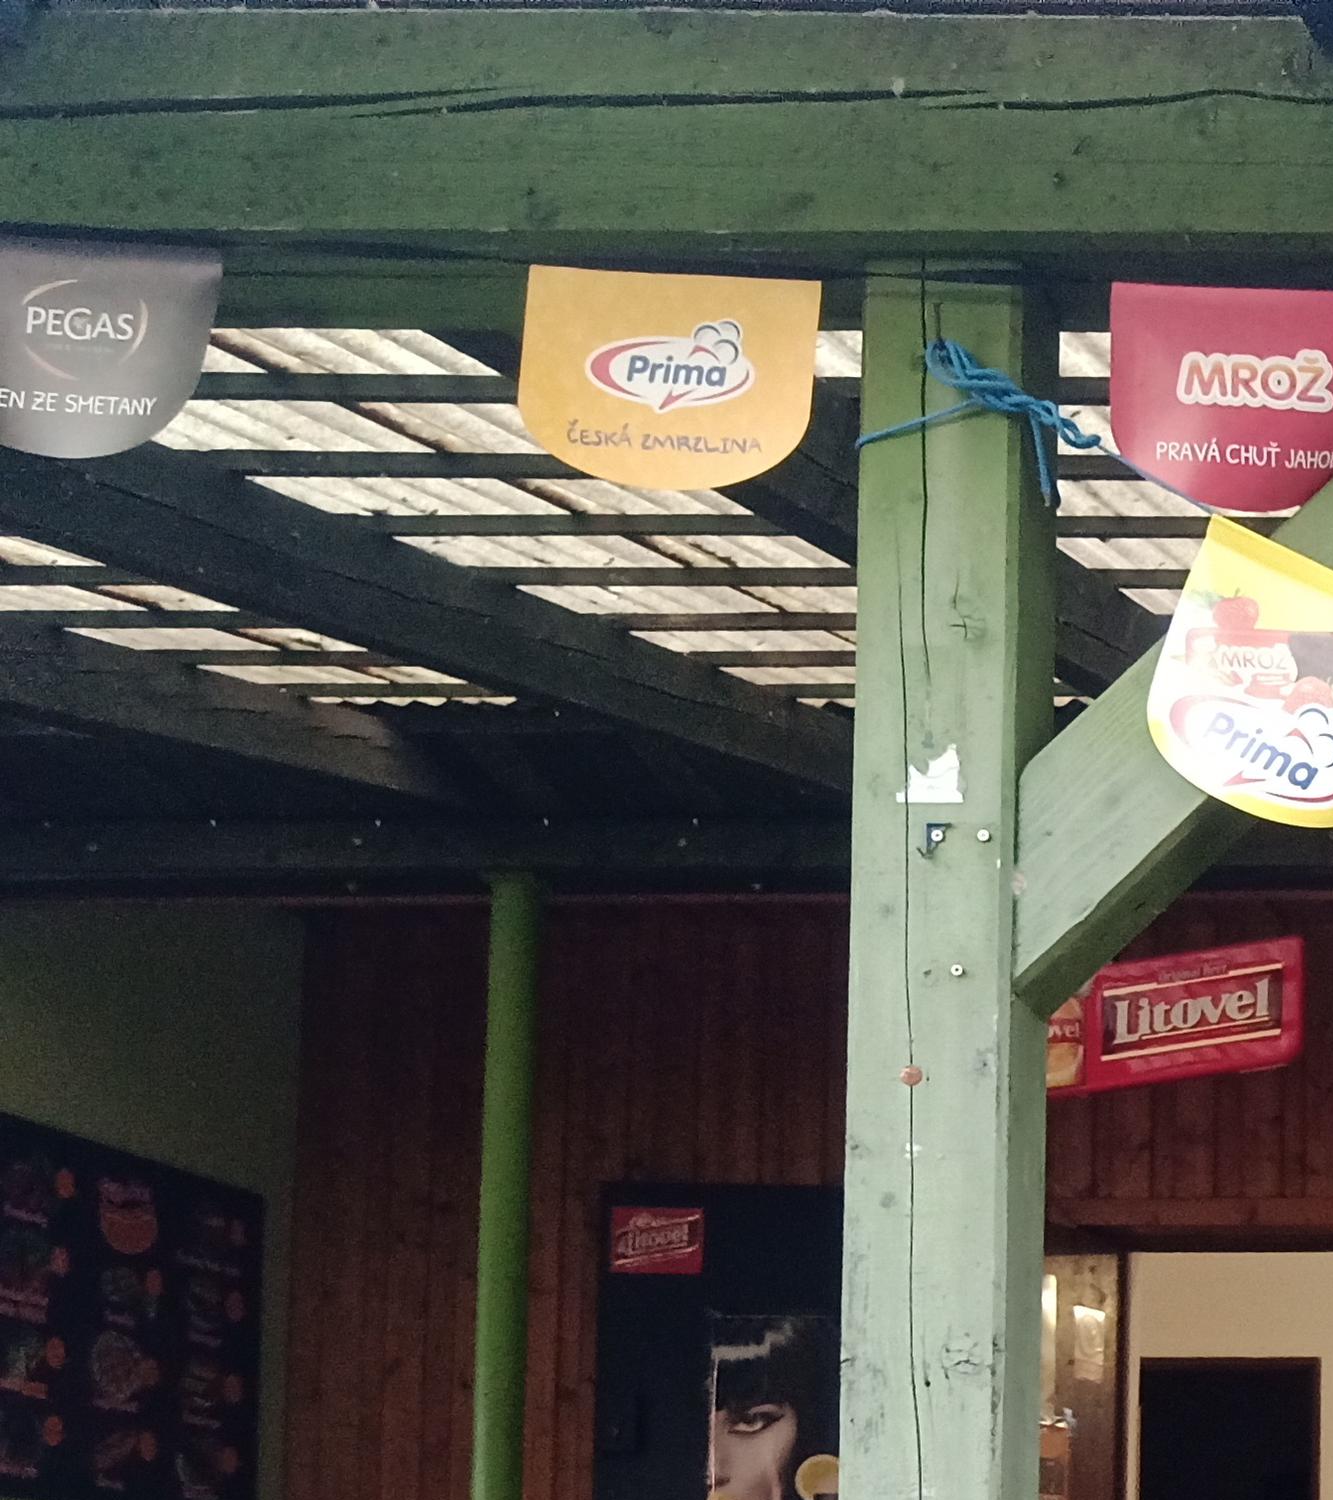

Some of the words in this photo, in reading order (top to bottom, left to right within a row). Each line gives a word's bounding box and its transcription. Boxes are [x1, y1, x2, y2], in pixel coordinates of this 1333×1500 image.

[26, 306, 134, 339] PEGAS
[625, 355, 728, 388] Prima
[1184, 355, 1325, 403] MROŽ
[0, 388, 24, 408] EN
[31, 391, 58, 411] ZE
[65, 394, 157, 415] SMETANY
[566, 418, 631, 447] ČESKÁ
[642, 430, 763, 455] ZMRZLINA
[1155, 438, 1219, 465] PRAVÁ
[1224, 440, 1281, 468] CHUŤ
[1204, 711, 1318, 790] Prima
[1112, 976, 1271, 1044] Litovel
